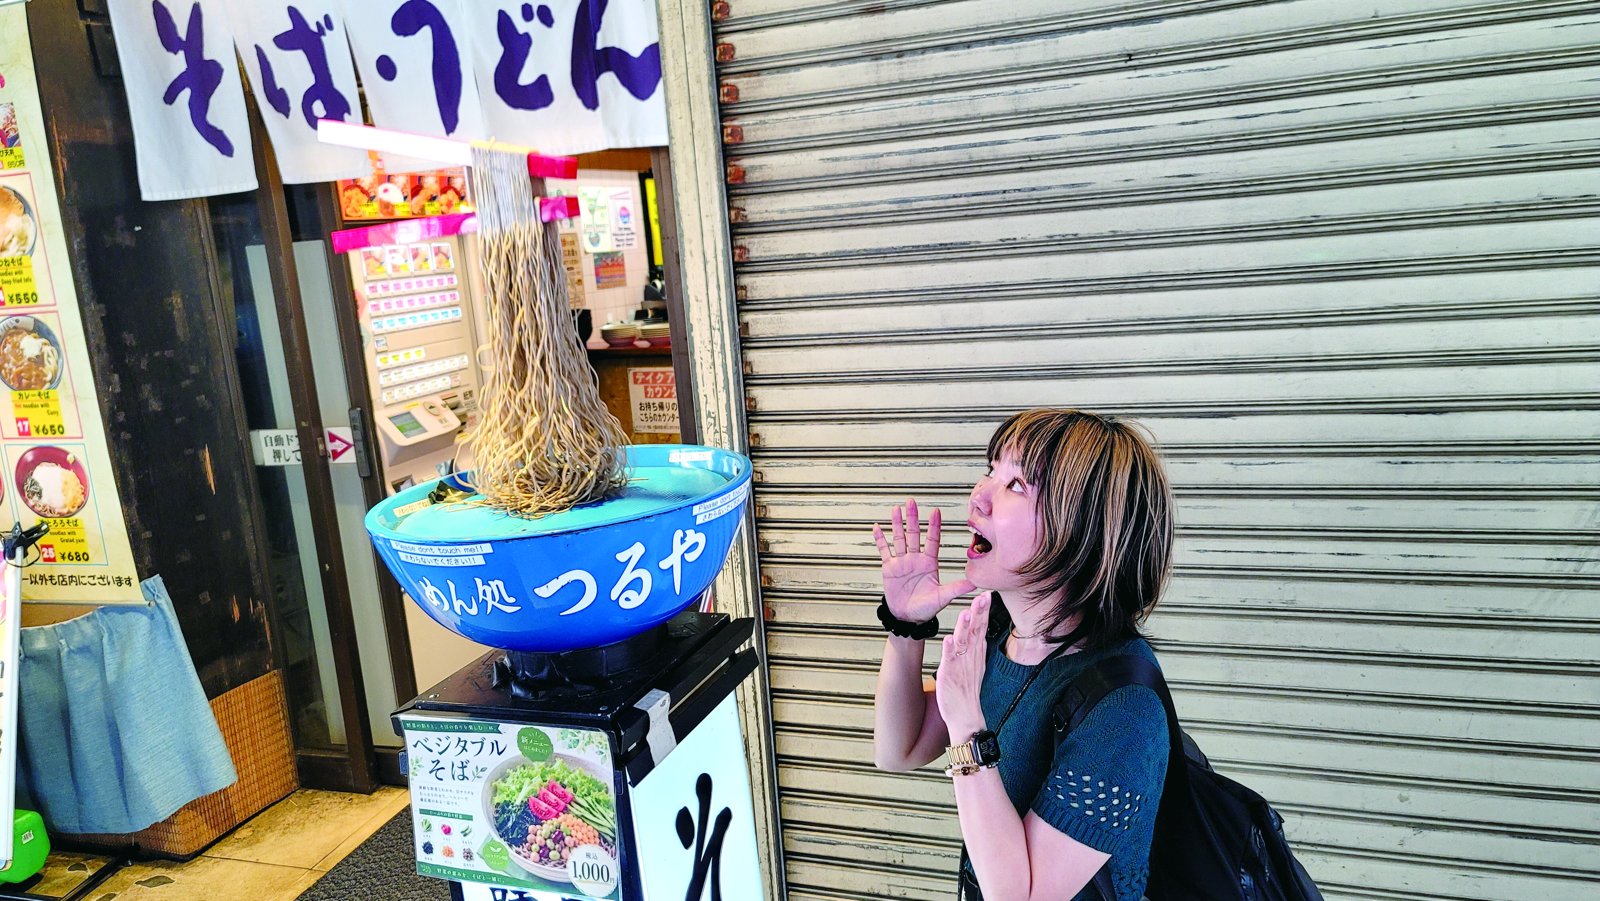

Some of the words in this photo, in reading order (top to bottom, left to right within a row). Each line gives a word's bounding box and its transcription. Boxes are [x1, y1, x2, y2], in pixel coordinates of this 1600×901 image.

[153, 0, 661, 157] そば・うどん
[8, 293, 38, 304] ¥550
[18, 391, 50, 400] カレーそば
[639, 401, 678, 412] お持ち帰りの
[17, 420, 29, 432] 17
[34, 424, 65, 436] ¥650
[60, 551, 90, 562] ¥680
[437, 546, 461, 554] touch
[418, 575, 522, 617] めん処
[533, 528, 707, 616] つるや
[411, 735, 509, 757] ベジタブル
[428, 758, 472, 782] そば
